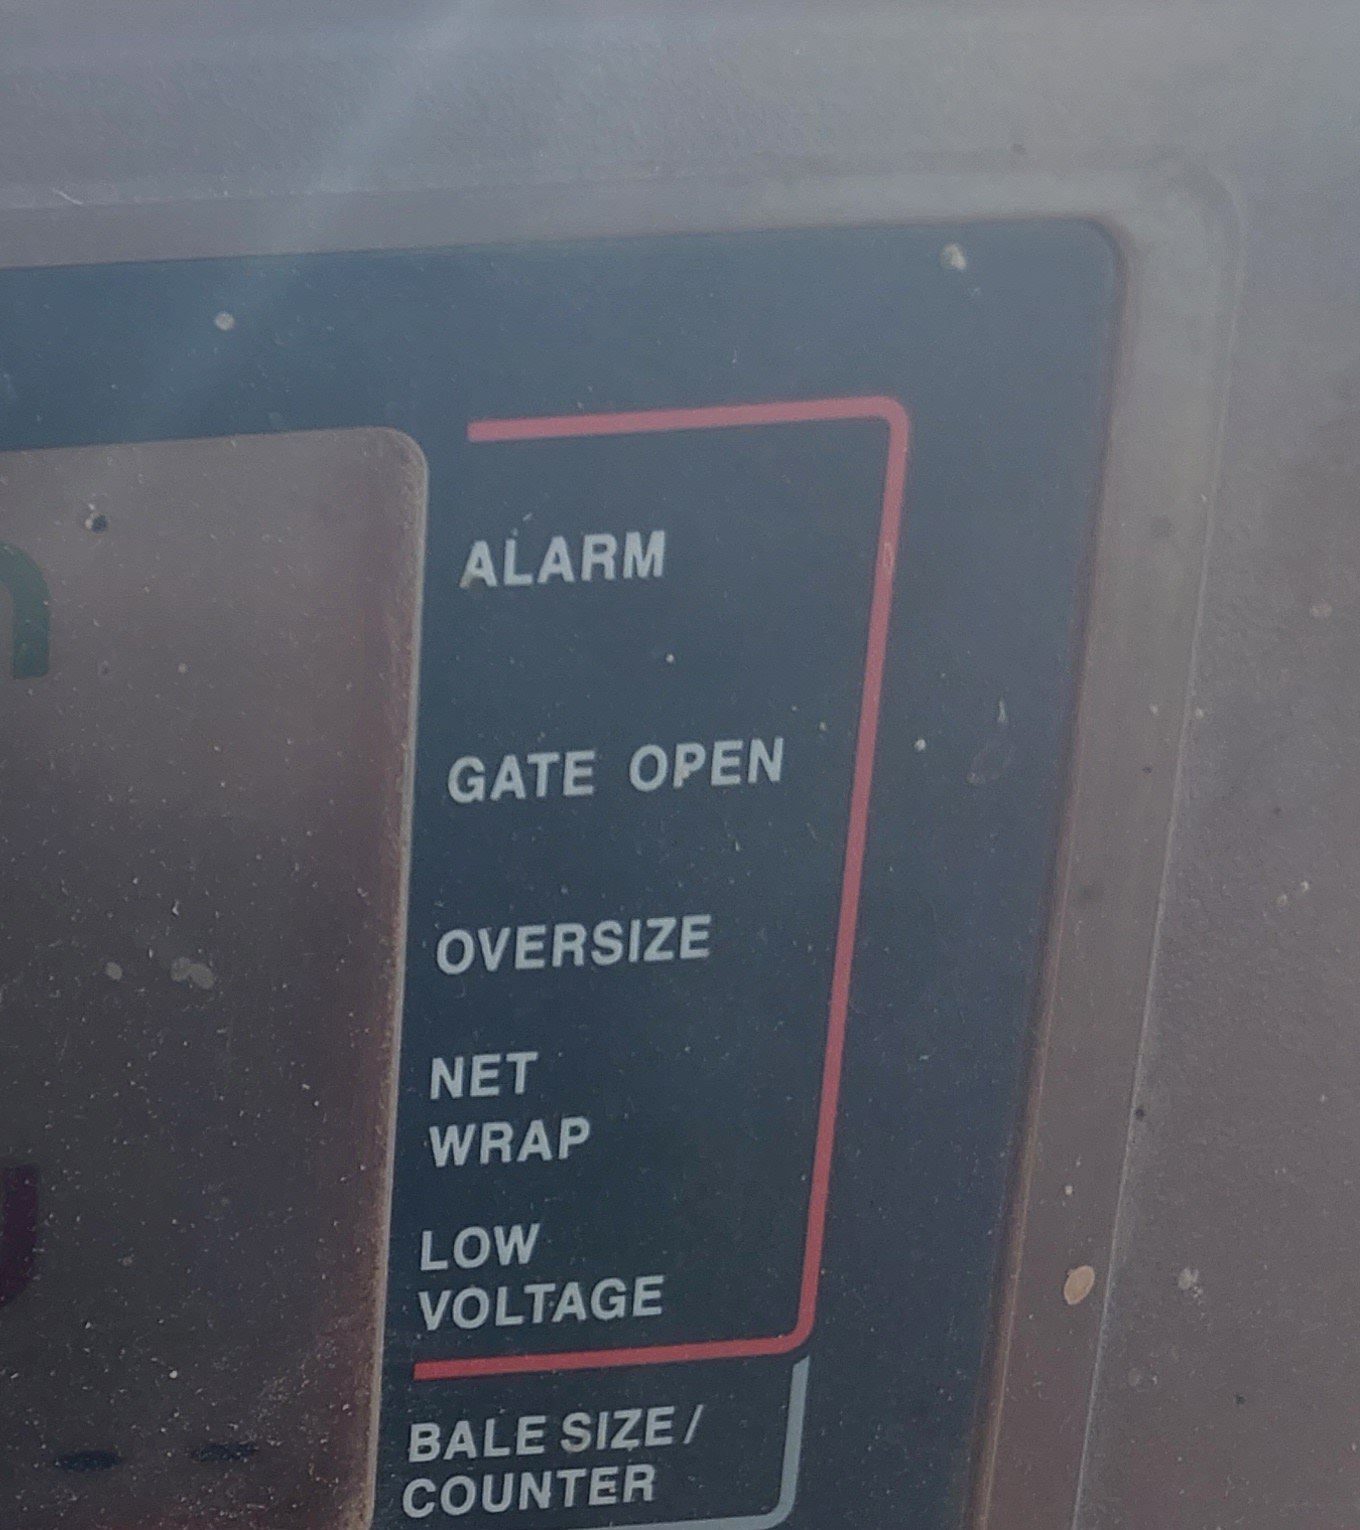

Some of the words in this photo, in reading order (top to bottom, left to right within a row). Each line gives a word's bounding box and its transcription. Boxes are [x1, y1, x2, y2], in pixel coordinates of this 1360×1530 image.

[459, 529, 666, 589] ALARM
[448, 749, 596, 803] GATE
[630, 736, 785, 792] OPEN
[437, 914, 712, 975] OVERSIZE
[430, 1051, 539, 1100] NET
[429, 1116, 591, 1167] WRAP
[420, 1223, 541, 1271] LOW
[418, 1274, 665, 1331] VOLTAGE
[408, 1414, 546, 1463] BALE
[402, 1463, 656, 1518] COUNTER
